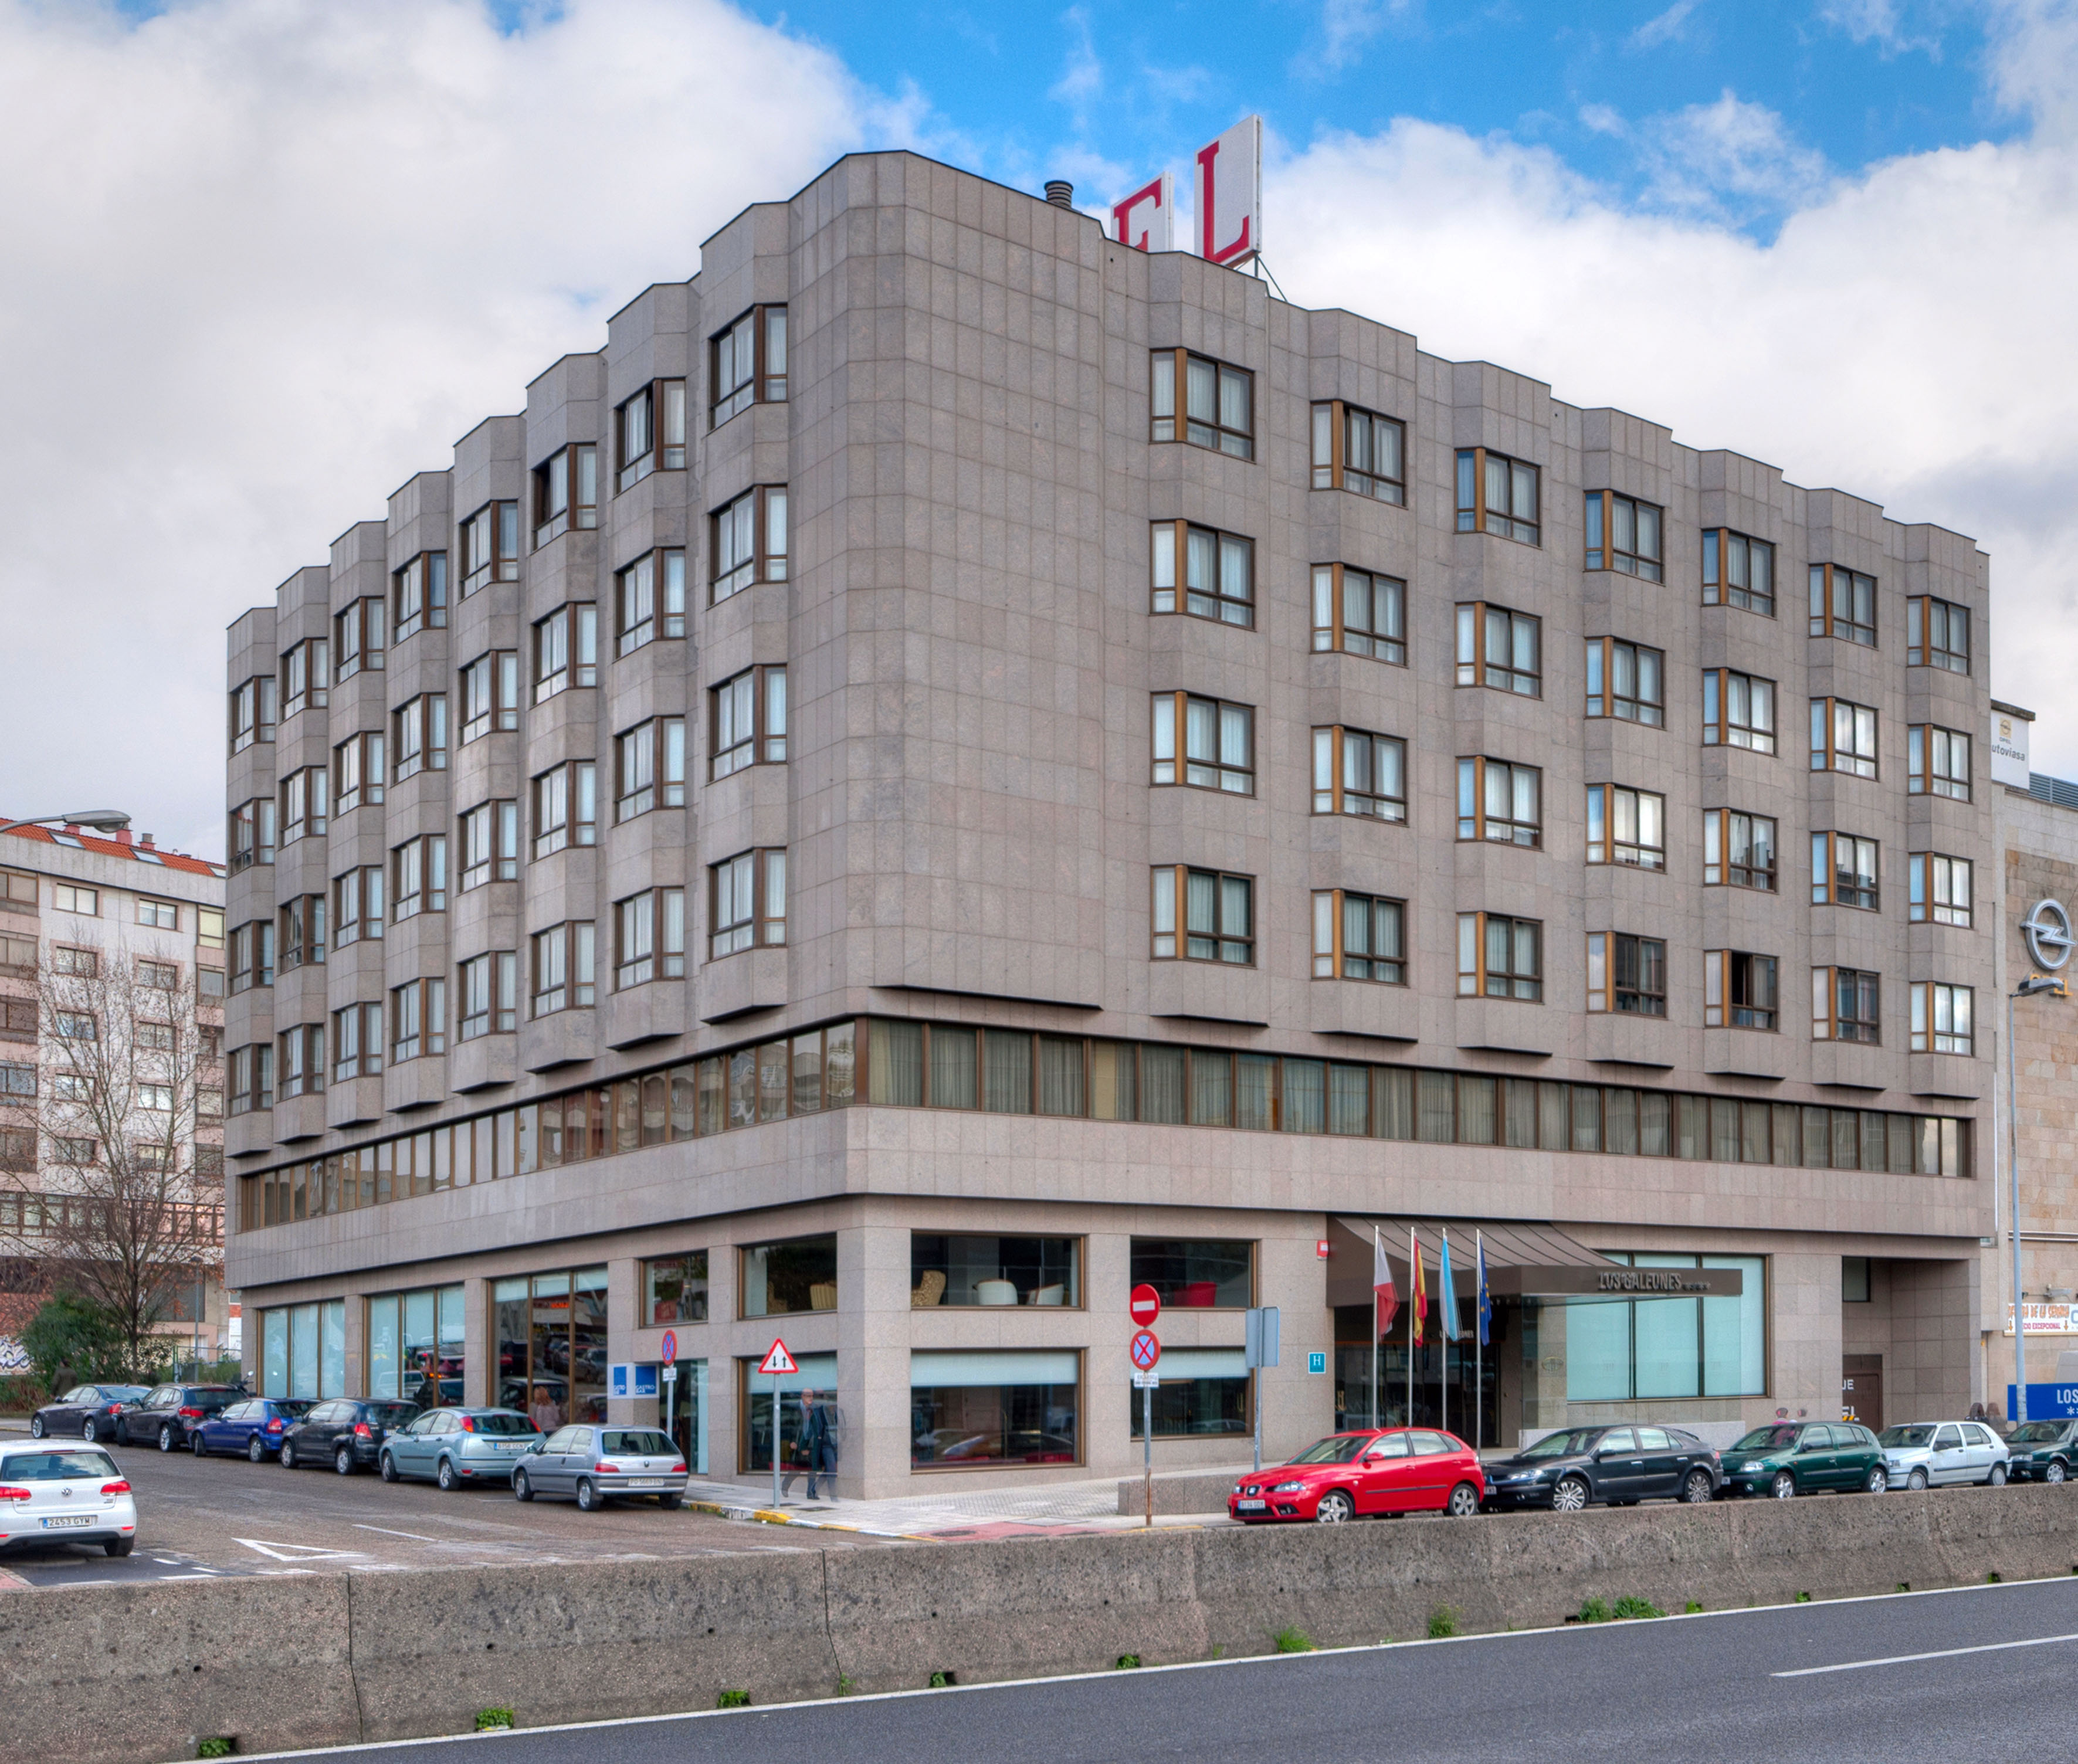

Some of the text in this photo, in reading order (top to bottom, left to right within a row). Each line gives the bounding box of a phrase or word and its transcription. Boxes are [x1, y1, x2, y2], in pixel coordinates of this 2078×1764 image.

[1991, 744, 2025, 761] utoviasa
[1599, 1271, 1682, 1290] LOS GALEONES
[1313, 1355, 1321, 1366] H
[2057, 1389, 2078, 1404] LOS
[49, 1518, 71, 1526] 2453
